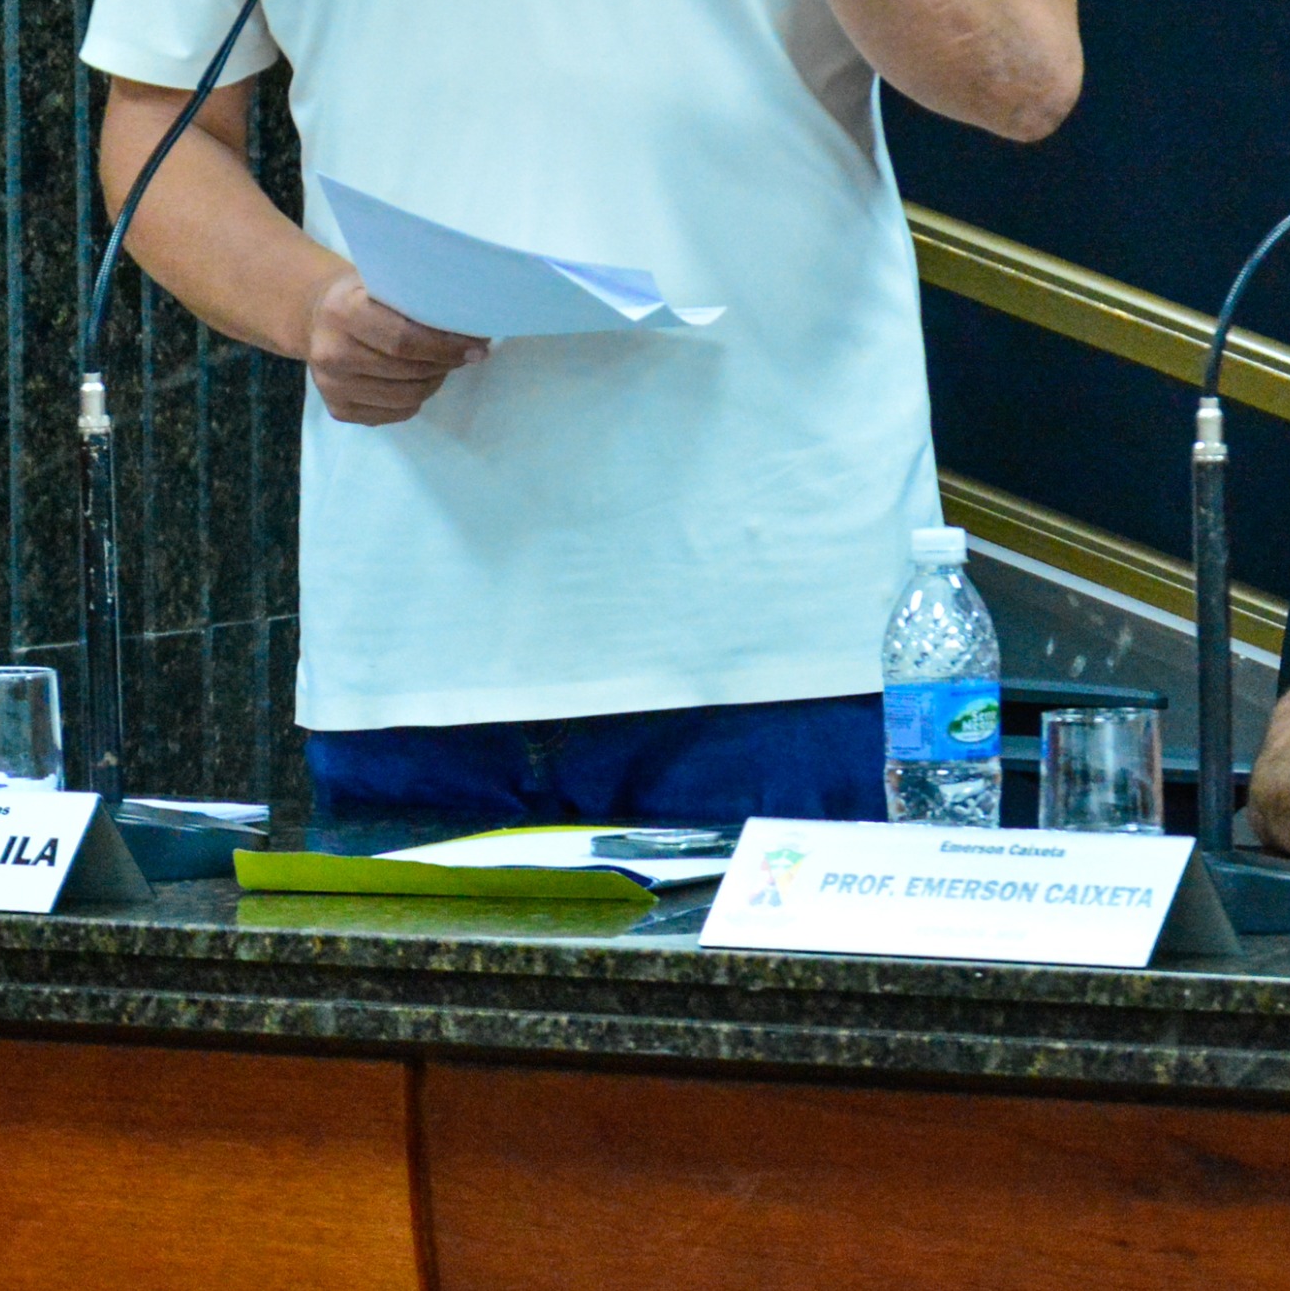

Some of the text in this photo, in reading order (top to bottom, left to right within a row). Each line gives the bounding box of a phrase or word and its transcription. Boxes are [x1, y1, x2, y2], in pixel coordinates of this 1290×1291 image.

[939, 840, 1066, 858] Emerson Caixeta
[819, 872, 1154, 908] PROF. EMERSON CAIXETA
